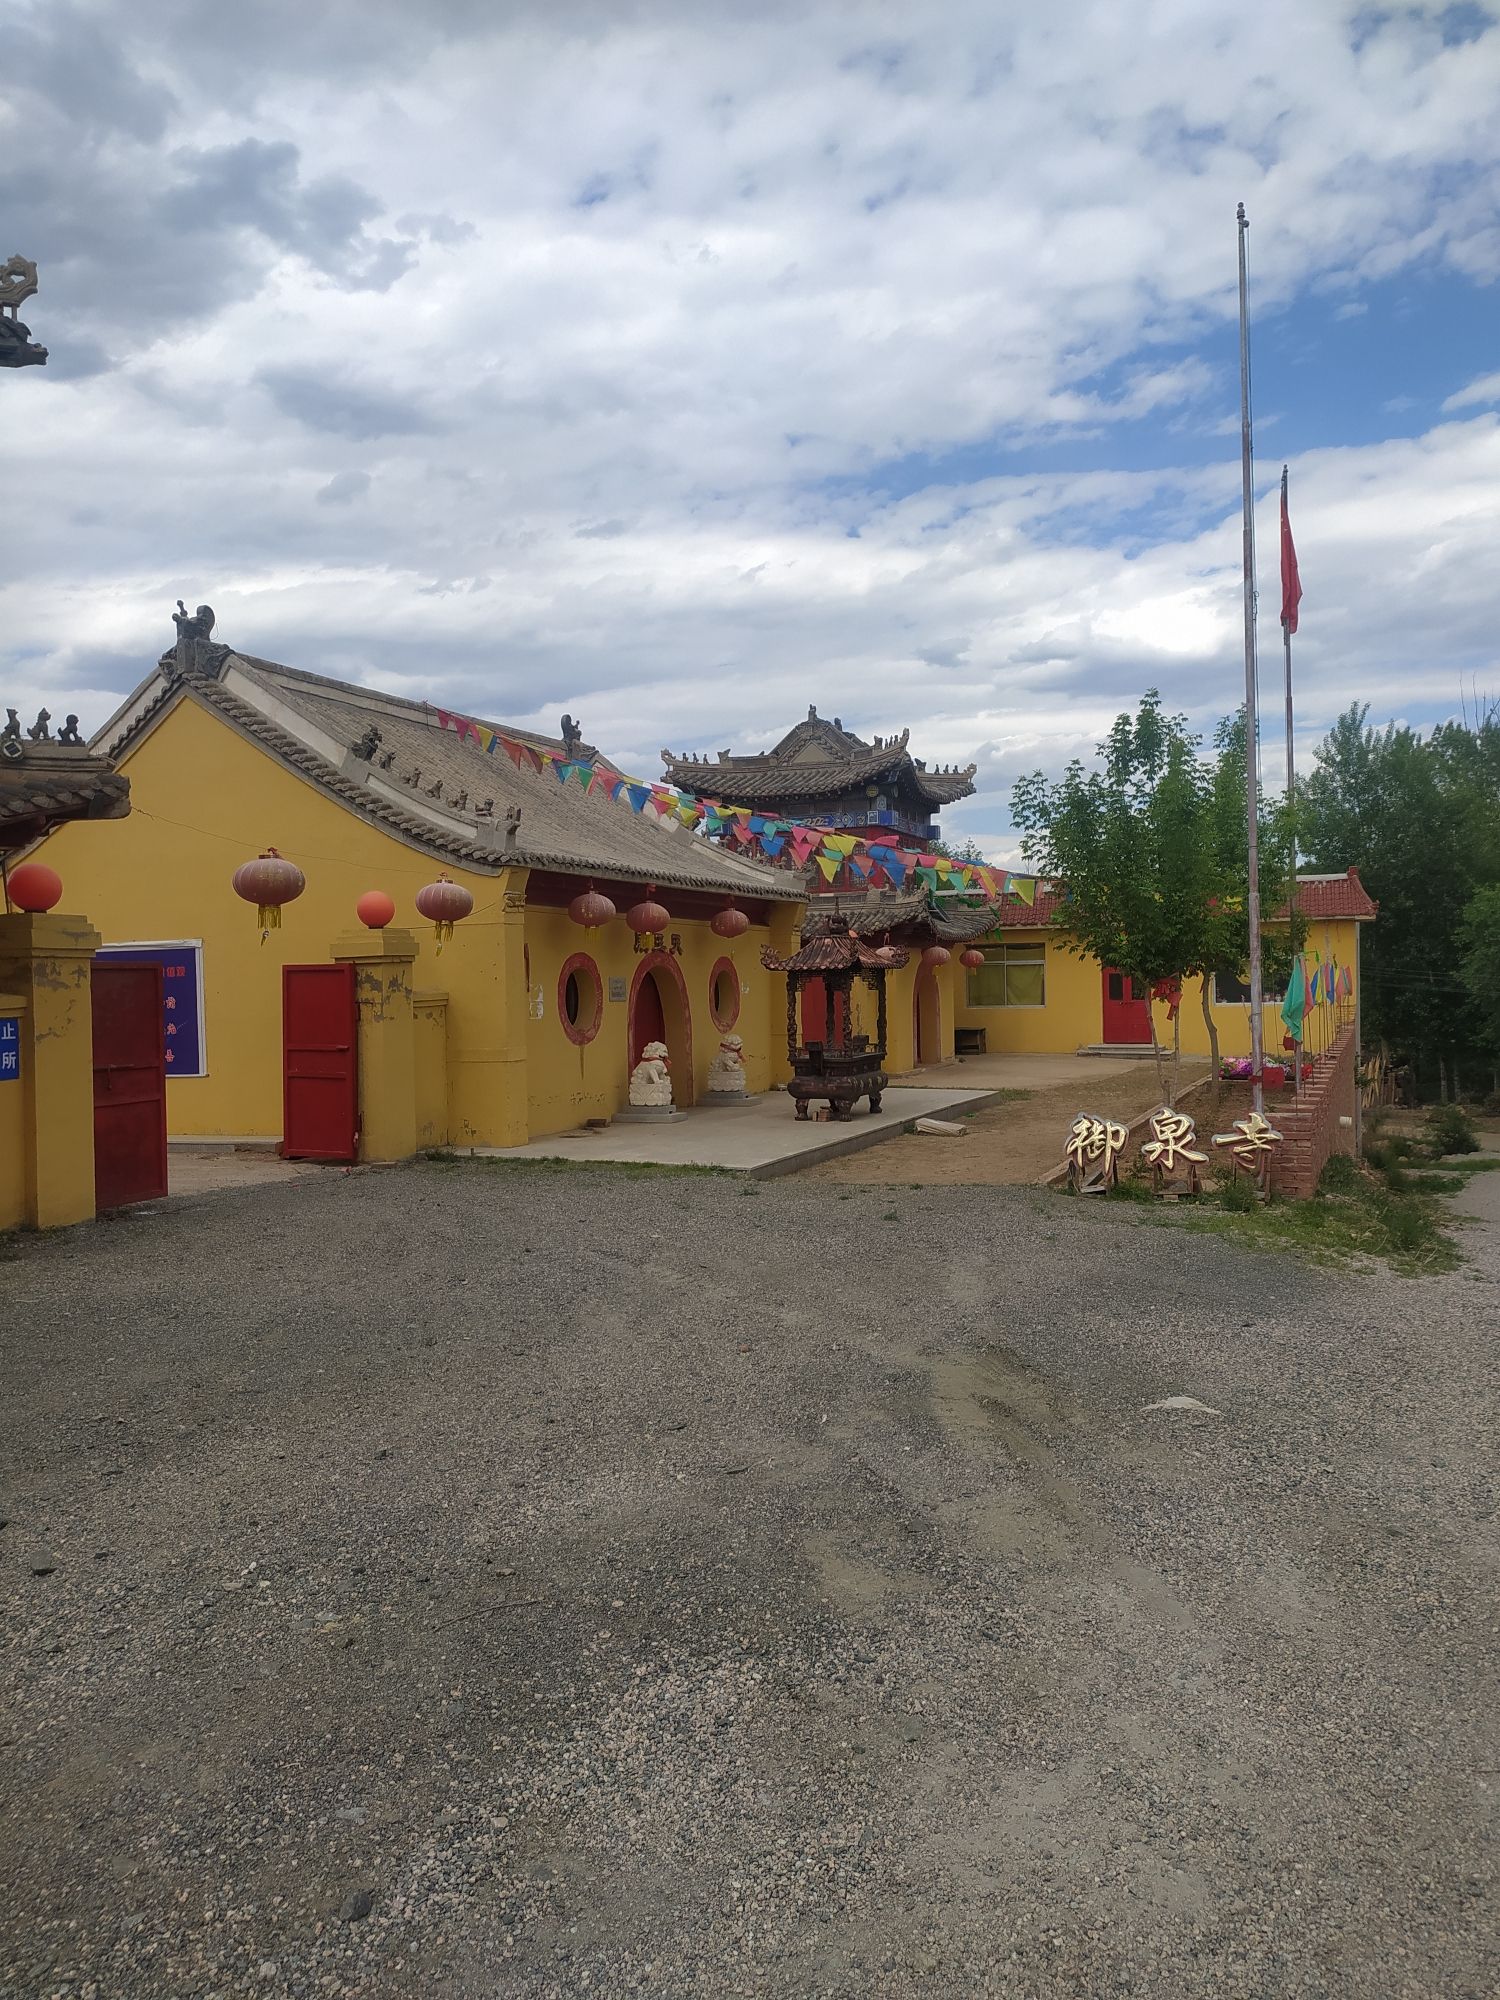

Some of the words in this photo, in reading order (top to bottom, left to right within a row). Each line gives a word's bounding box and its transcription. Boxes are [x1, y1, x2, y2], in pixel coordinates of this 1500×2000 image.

[163, 966, 186, 977] 值观
[1065, 1107, 1284, 1176] 御泉寺
